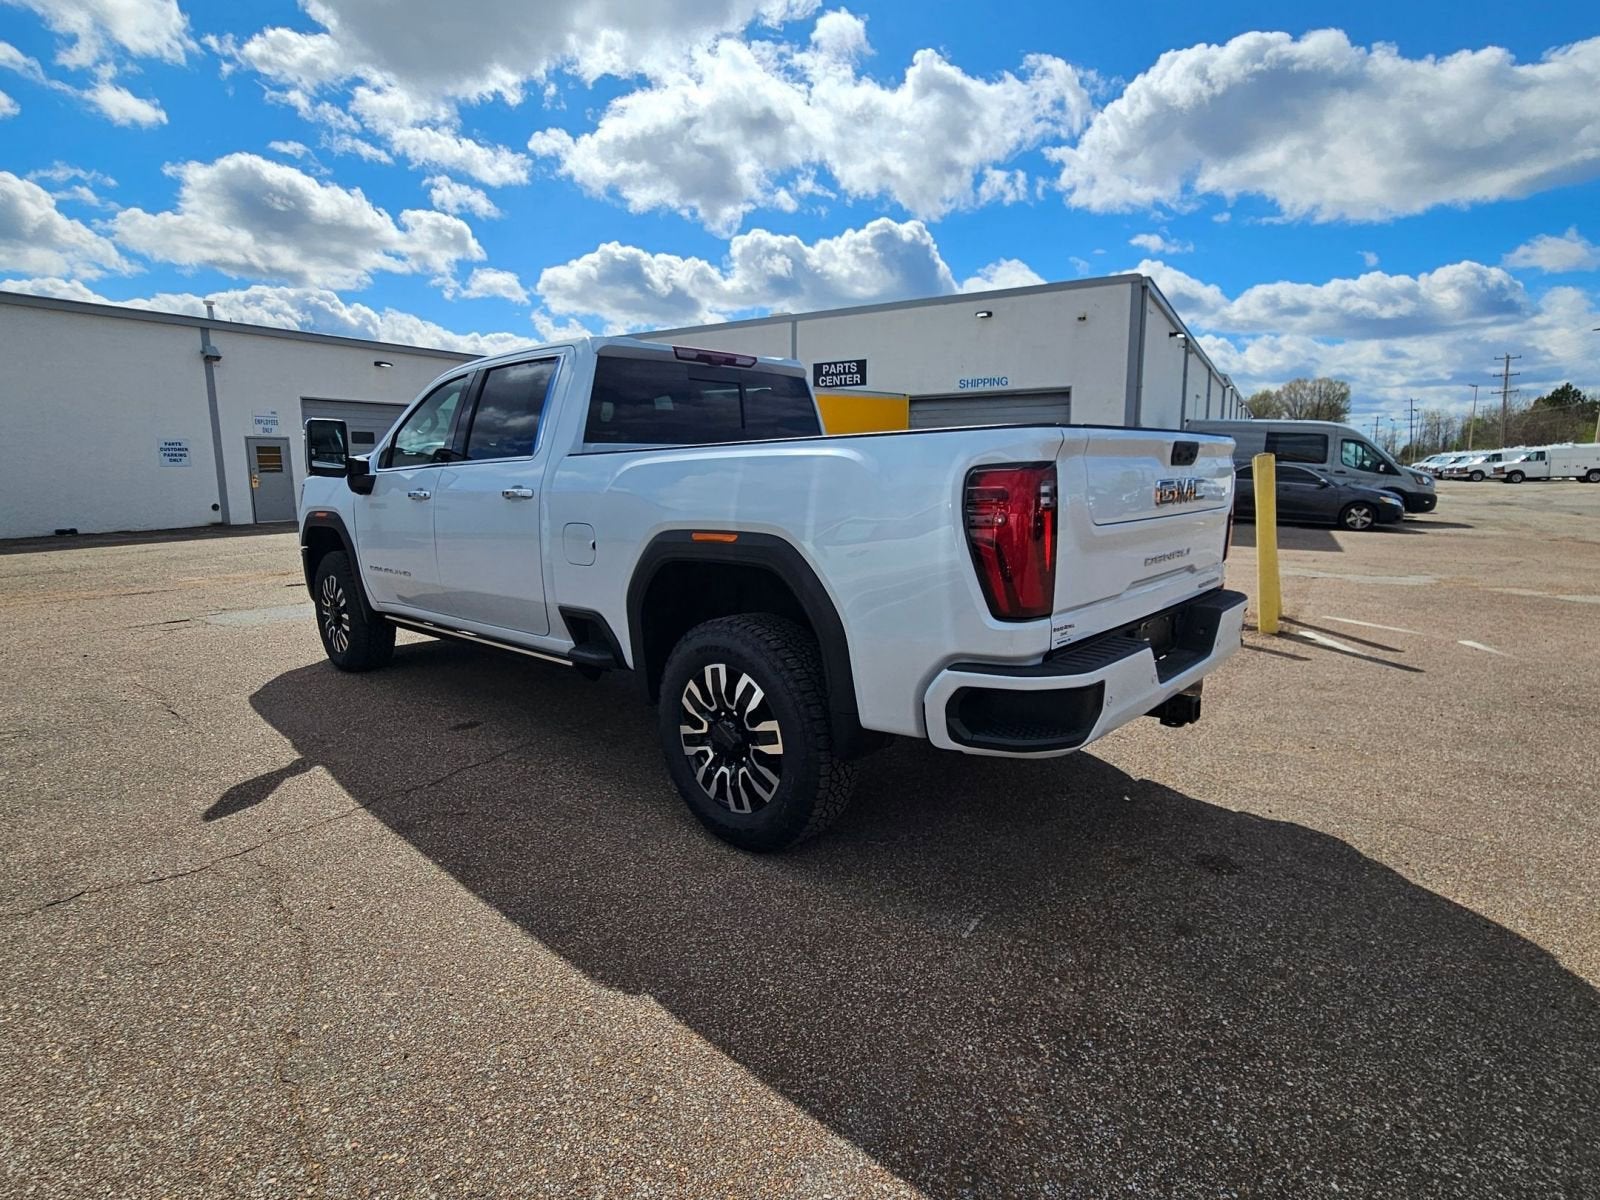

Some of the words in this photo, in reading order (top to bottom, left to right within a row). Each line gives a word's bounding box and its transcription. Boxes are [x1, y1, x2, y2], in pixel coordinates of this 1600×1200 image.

[822, 362, 858, 375] PARTS
[818, 374, 861, 387] CENTER
[959, 376, 1009, 389] SHIPPING
[254, 418, 279, 426] EMPLOYEES
[1155, 478, 1206, 506] GMC
